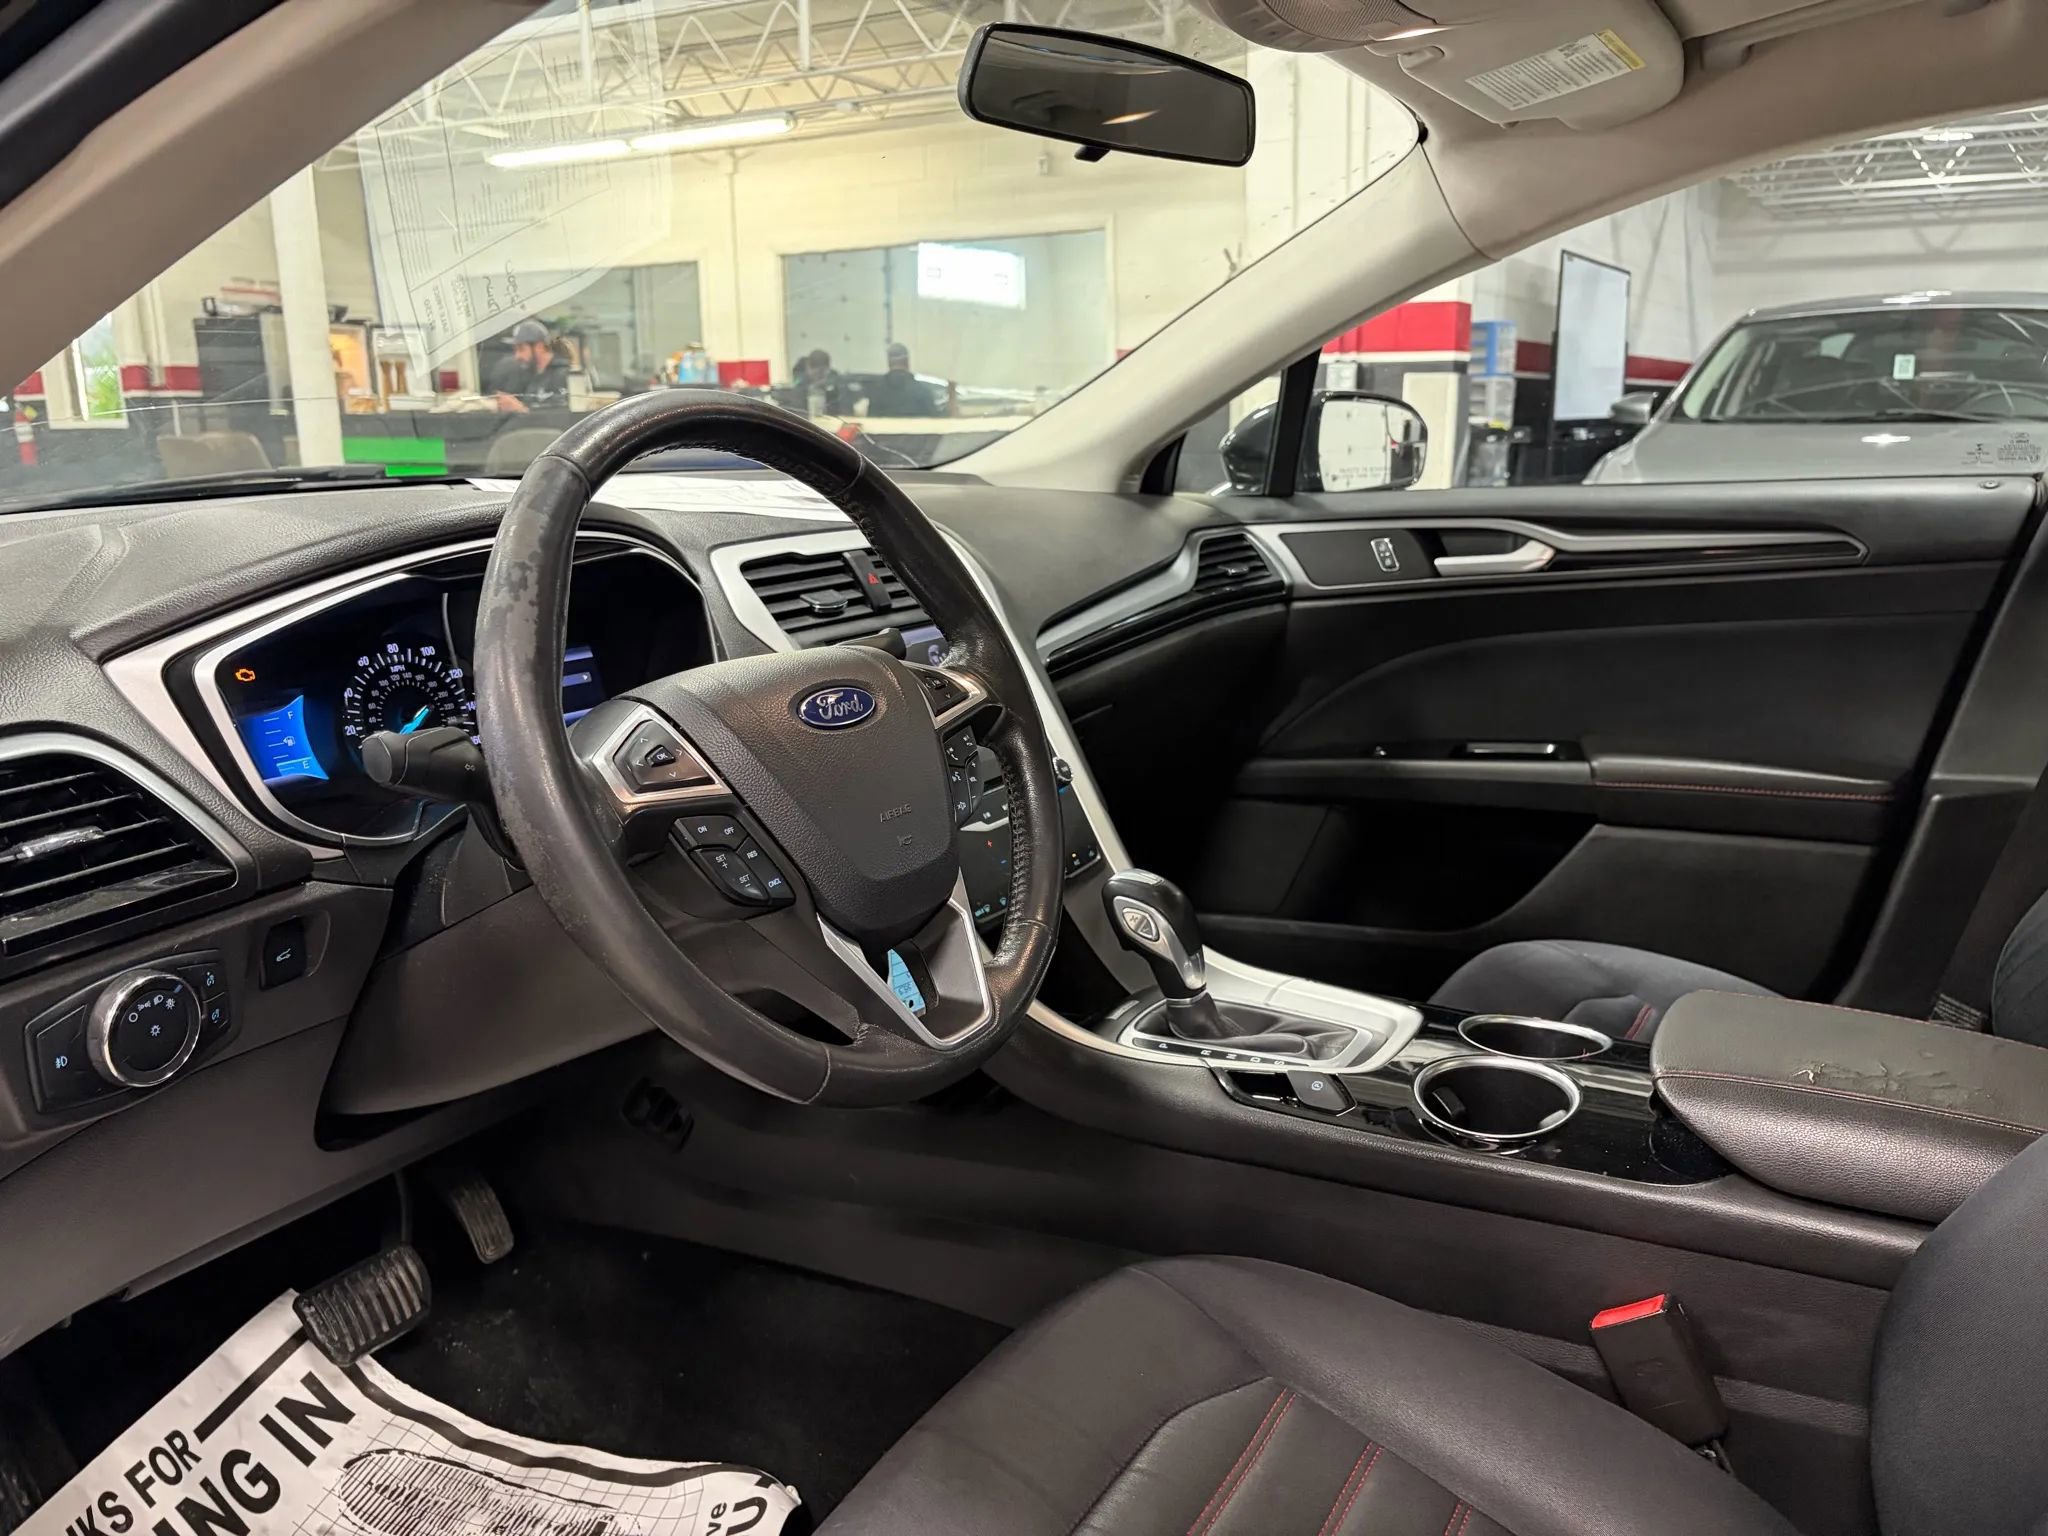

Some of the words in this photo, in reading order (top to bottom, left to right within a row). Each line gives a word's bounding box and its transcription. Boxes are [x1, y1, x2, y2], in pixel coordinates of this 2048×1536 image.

[387, 643, 398, 653] 80
[420, 646, 435, 656] 100
[358, 656, 369, 666] 60
[390, 665, 406, 673] MPH
[449, 668, 463, 679] 120
[816, 692, 863, 720] Ford
[287, 711, 294, 719] F
[345, 725, 356, 736] 20
[657, 752, 668, 760] OK
[303, 760, 310, 769] E
[698, 826, 707, 834] ON
[724, 826, 735, 835] OFF
[715, 854, 726, 863] SET
[746, 850, 758, 859] RES
[739, 874, 750, 884] SET
[768, 878, 781, 888] CNCL
[259, 1371, 356, 1467] IN
[124, 1429, 201, 1509] FOR
